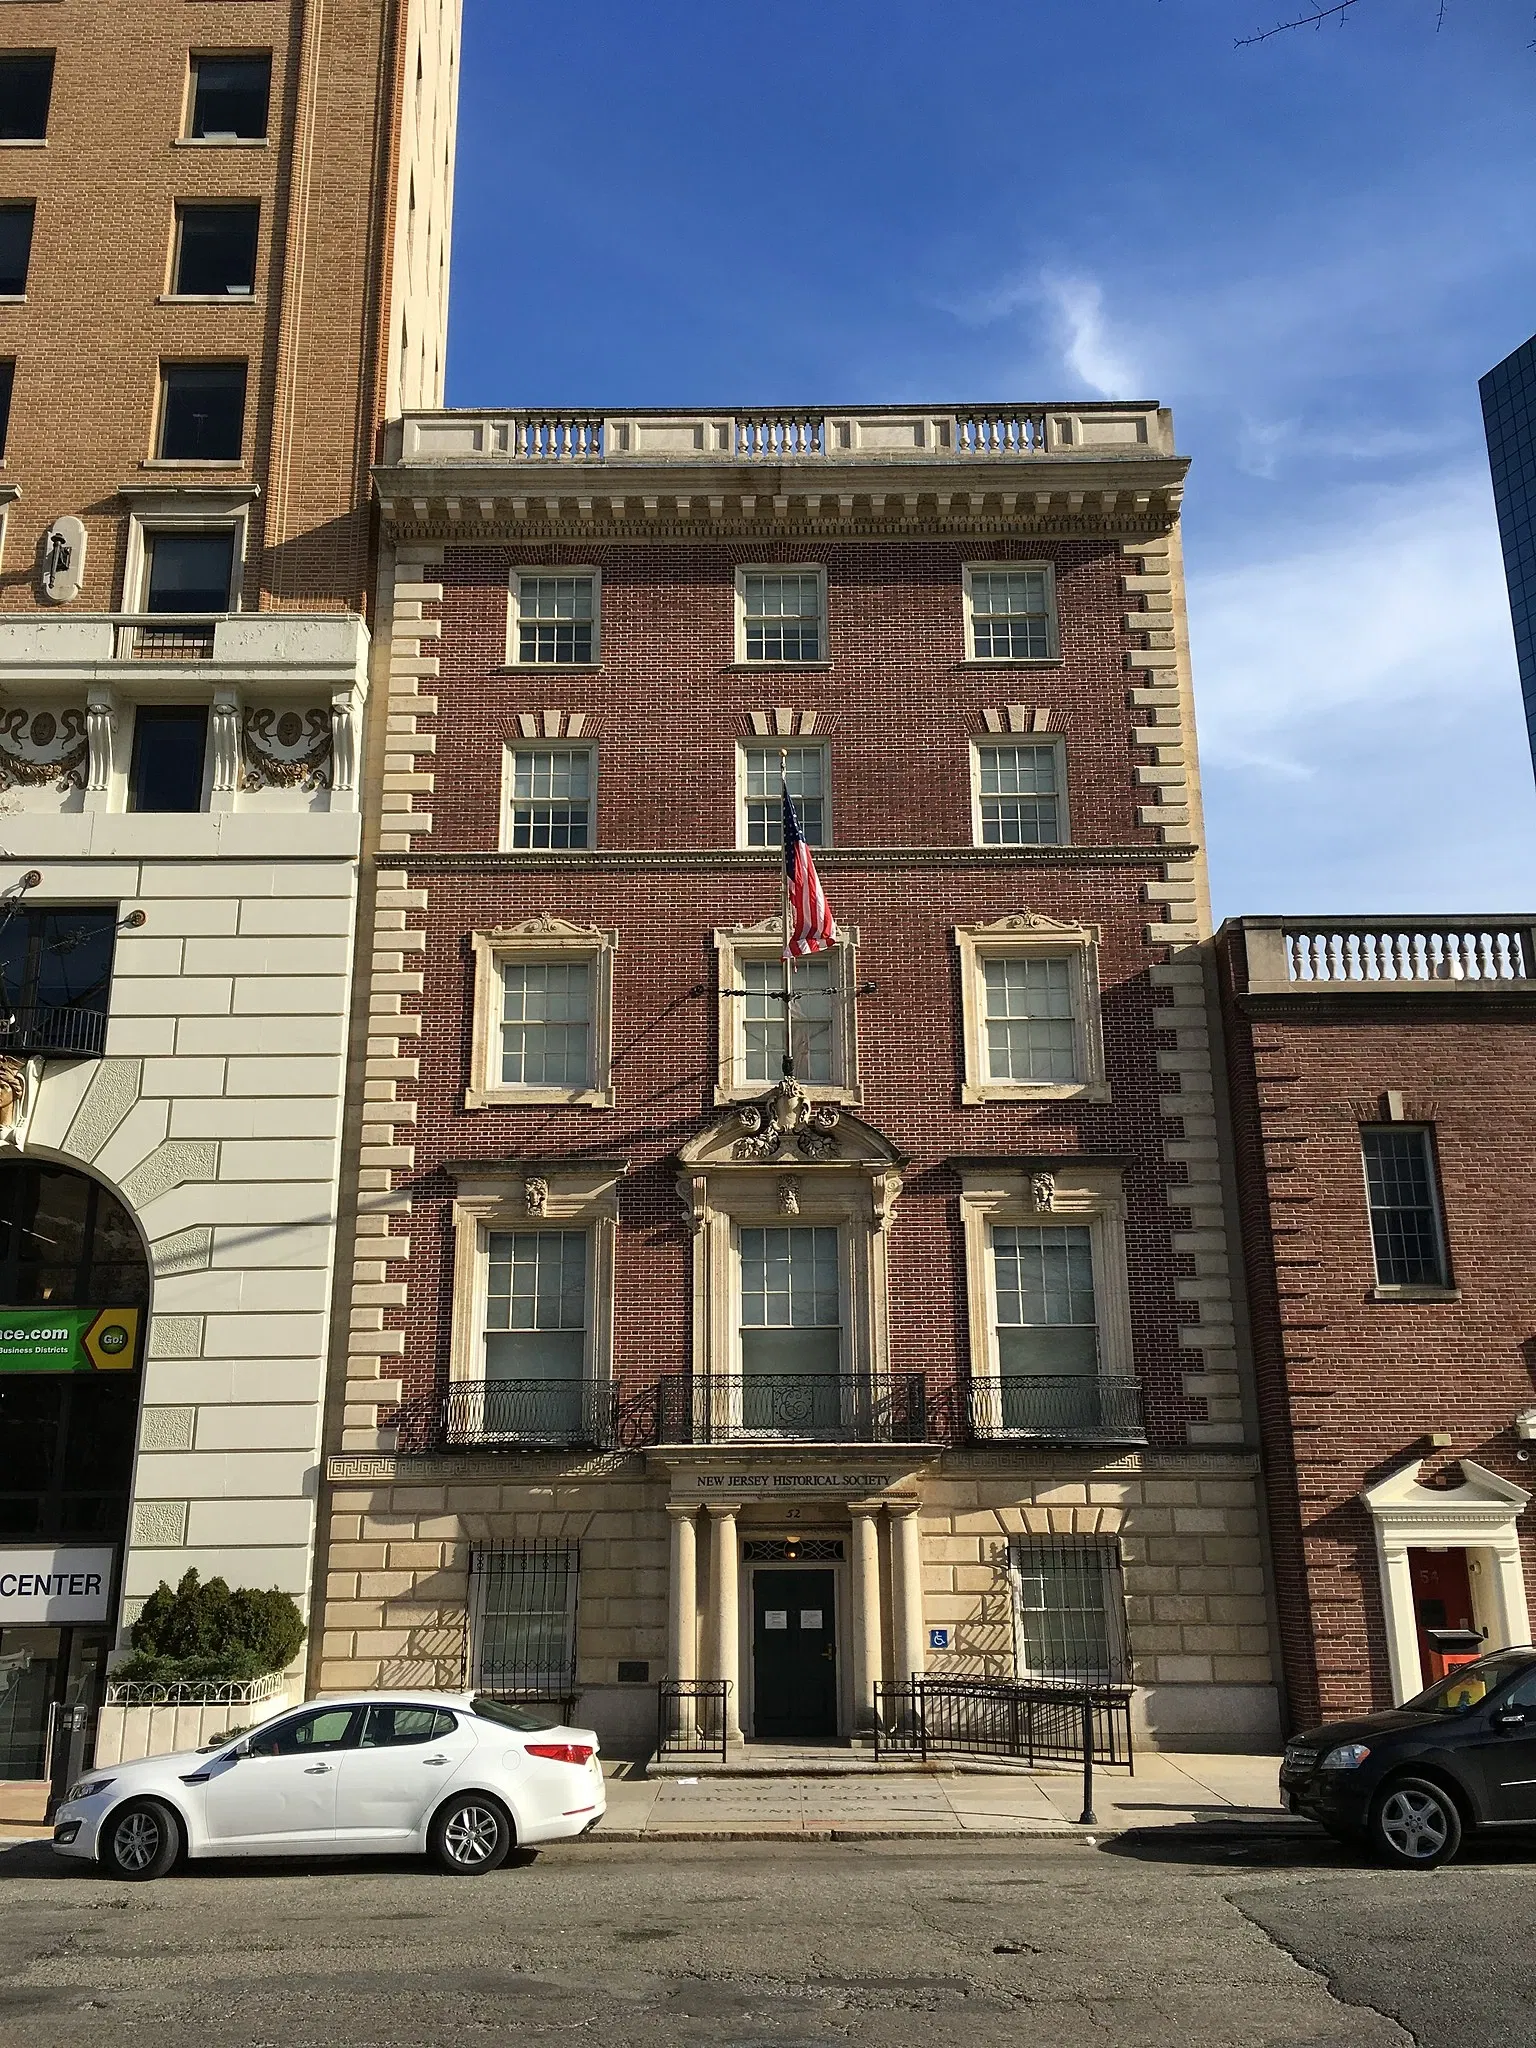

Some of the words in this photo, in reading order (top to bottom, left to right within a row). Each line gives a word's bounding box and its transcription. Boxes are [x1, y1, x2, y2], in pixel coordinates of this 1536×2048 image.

[0, 1329, 68, 1339] ce.com
[103, 1334, 123, 1344] Go!
[34, 1346, 68, 1354] Districts
[697, 1476, 724, 1486] NEW
[728, 1475, 769, 1486] JERSEY
[773, 1475, 840, 1486] HISTORICAL
[843, 1475, 891, 1485] SOCIETY
[786, 1509, 800, 1518] 52
[0, 1573, 102, 1597] CENTER
